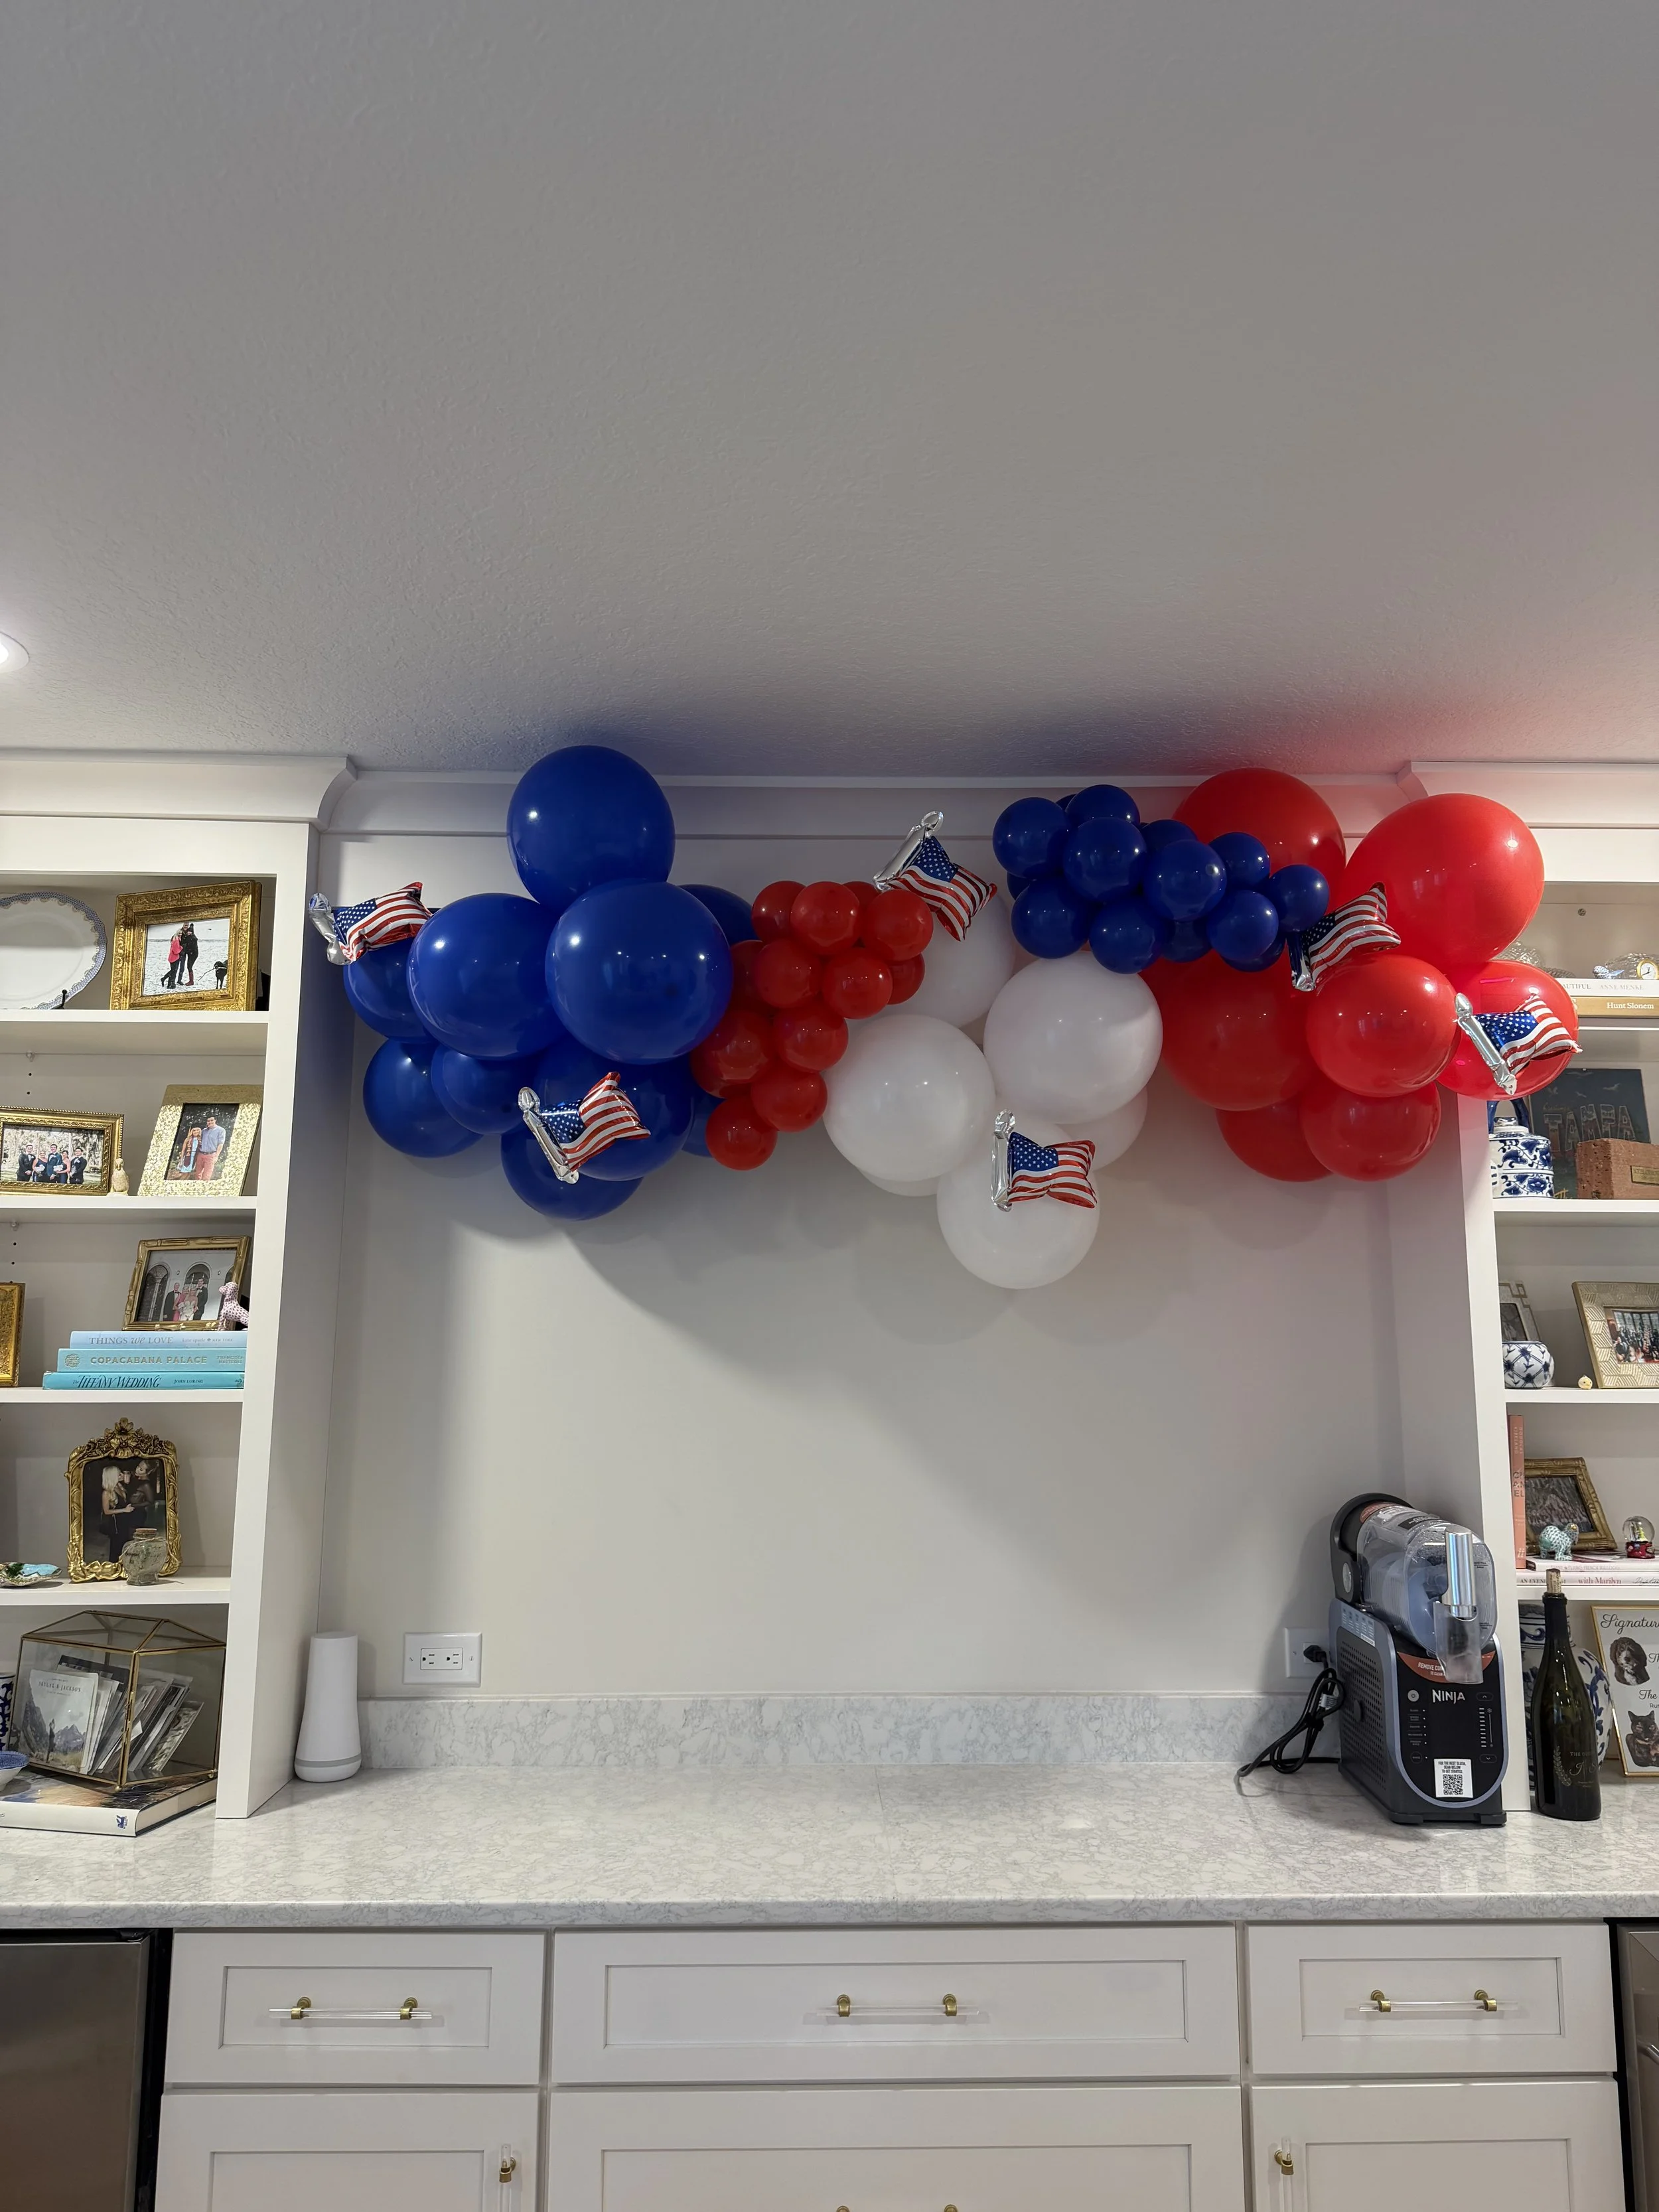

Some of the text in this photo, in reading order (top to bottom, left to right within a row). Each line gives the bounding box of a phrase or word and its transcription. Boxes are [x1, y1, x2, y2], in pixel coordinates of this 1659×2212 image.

[1544, 1104, 1636, 1152] TAMPA
[78, 1374, 117, 1388] TIFFANY
[116, 1374, 161, 1388] WEDDING
[1601, 1614, 1659, 1635] Signatur
[1417, 1662, 1434, 1670] REMOVE
[1432, 1689, 1466, 1704] NINJA
[1638, 1689, 1658, 1700] The
